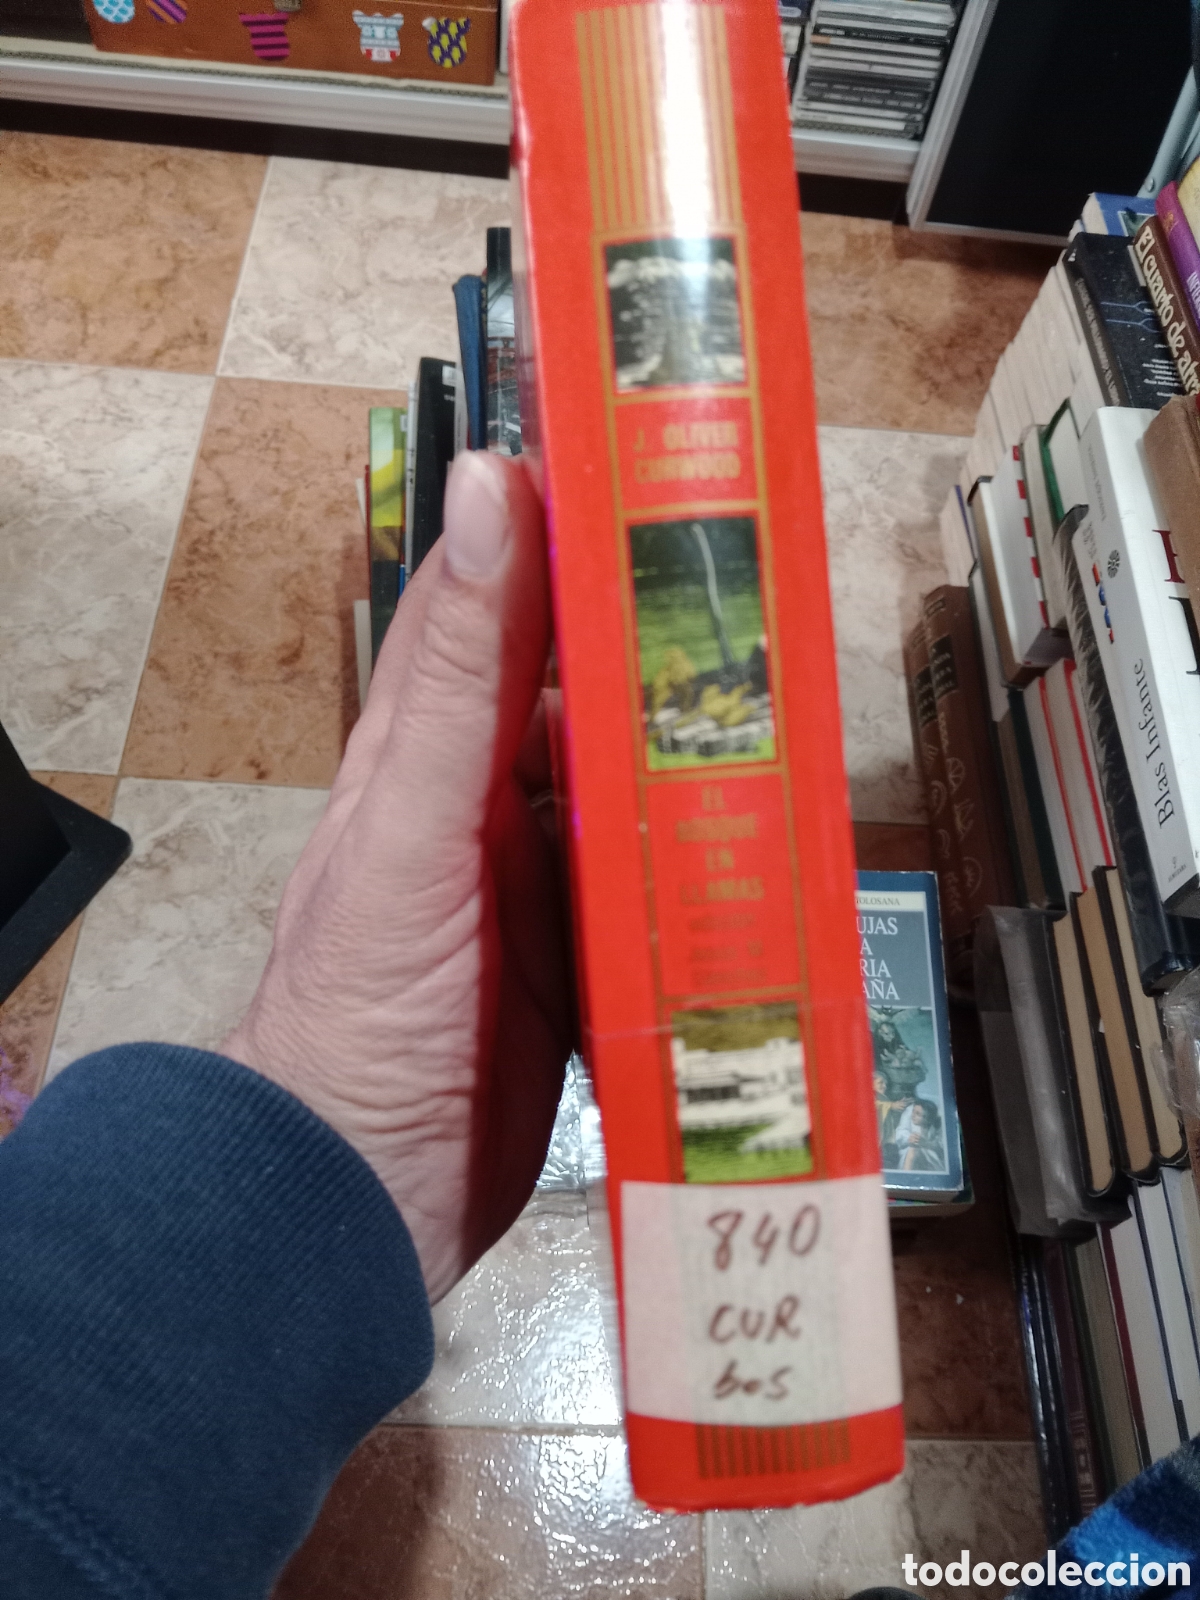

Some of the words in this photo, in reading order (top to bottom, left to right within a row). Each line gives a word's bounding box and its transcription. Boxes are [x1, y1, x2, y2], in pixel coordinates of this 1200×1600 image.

[1134, 225, 1155, 264] El
[1143, 254, 1174, 327] cuarto
[1166, 321, 1186, 358] de
[1134, 658, 1161, 763] Infante
[1153, 761, 1175, 829] Blas
[707, 1203, 821, 1270] 840
[708, 1295, 801, 1344] CUR
